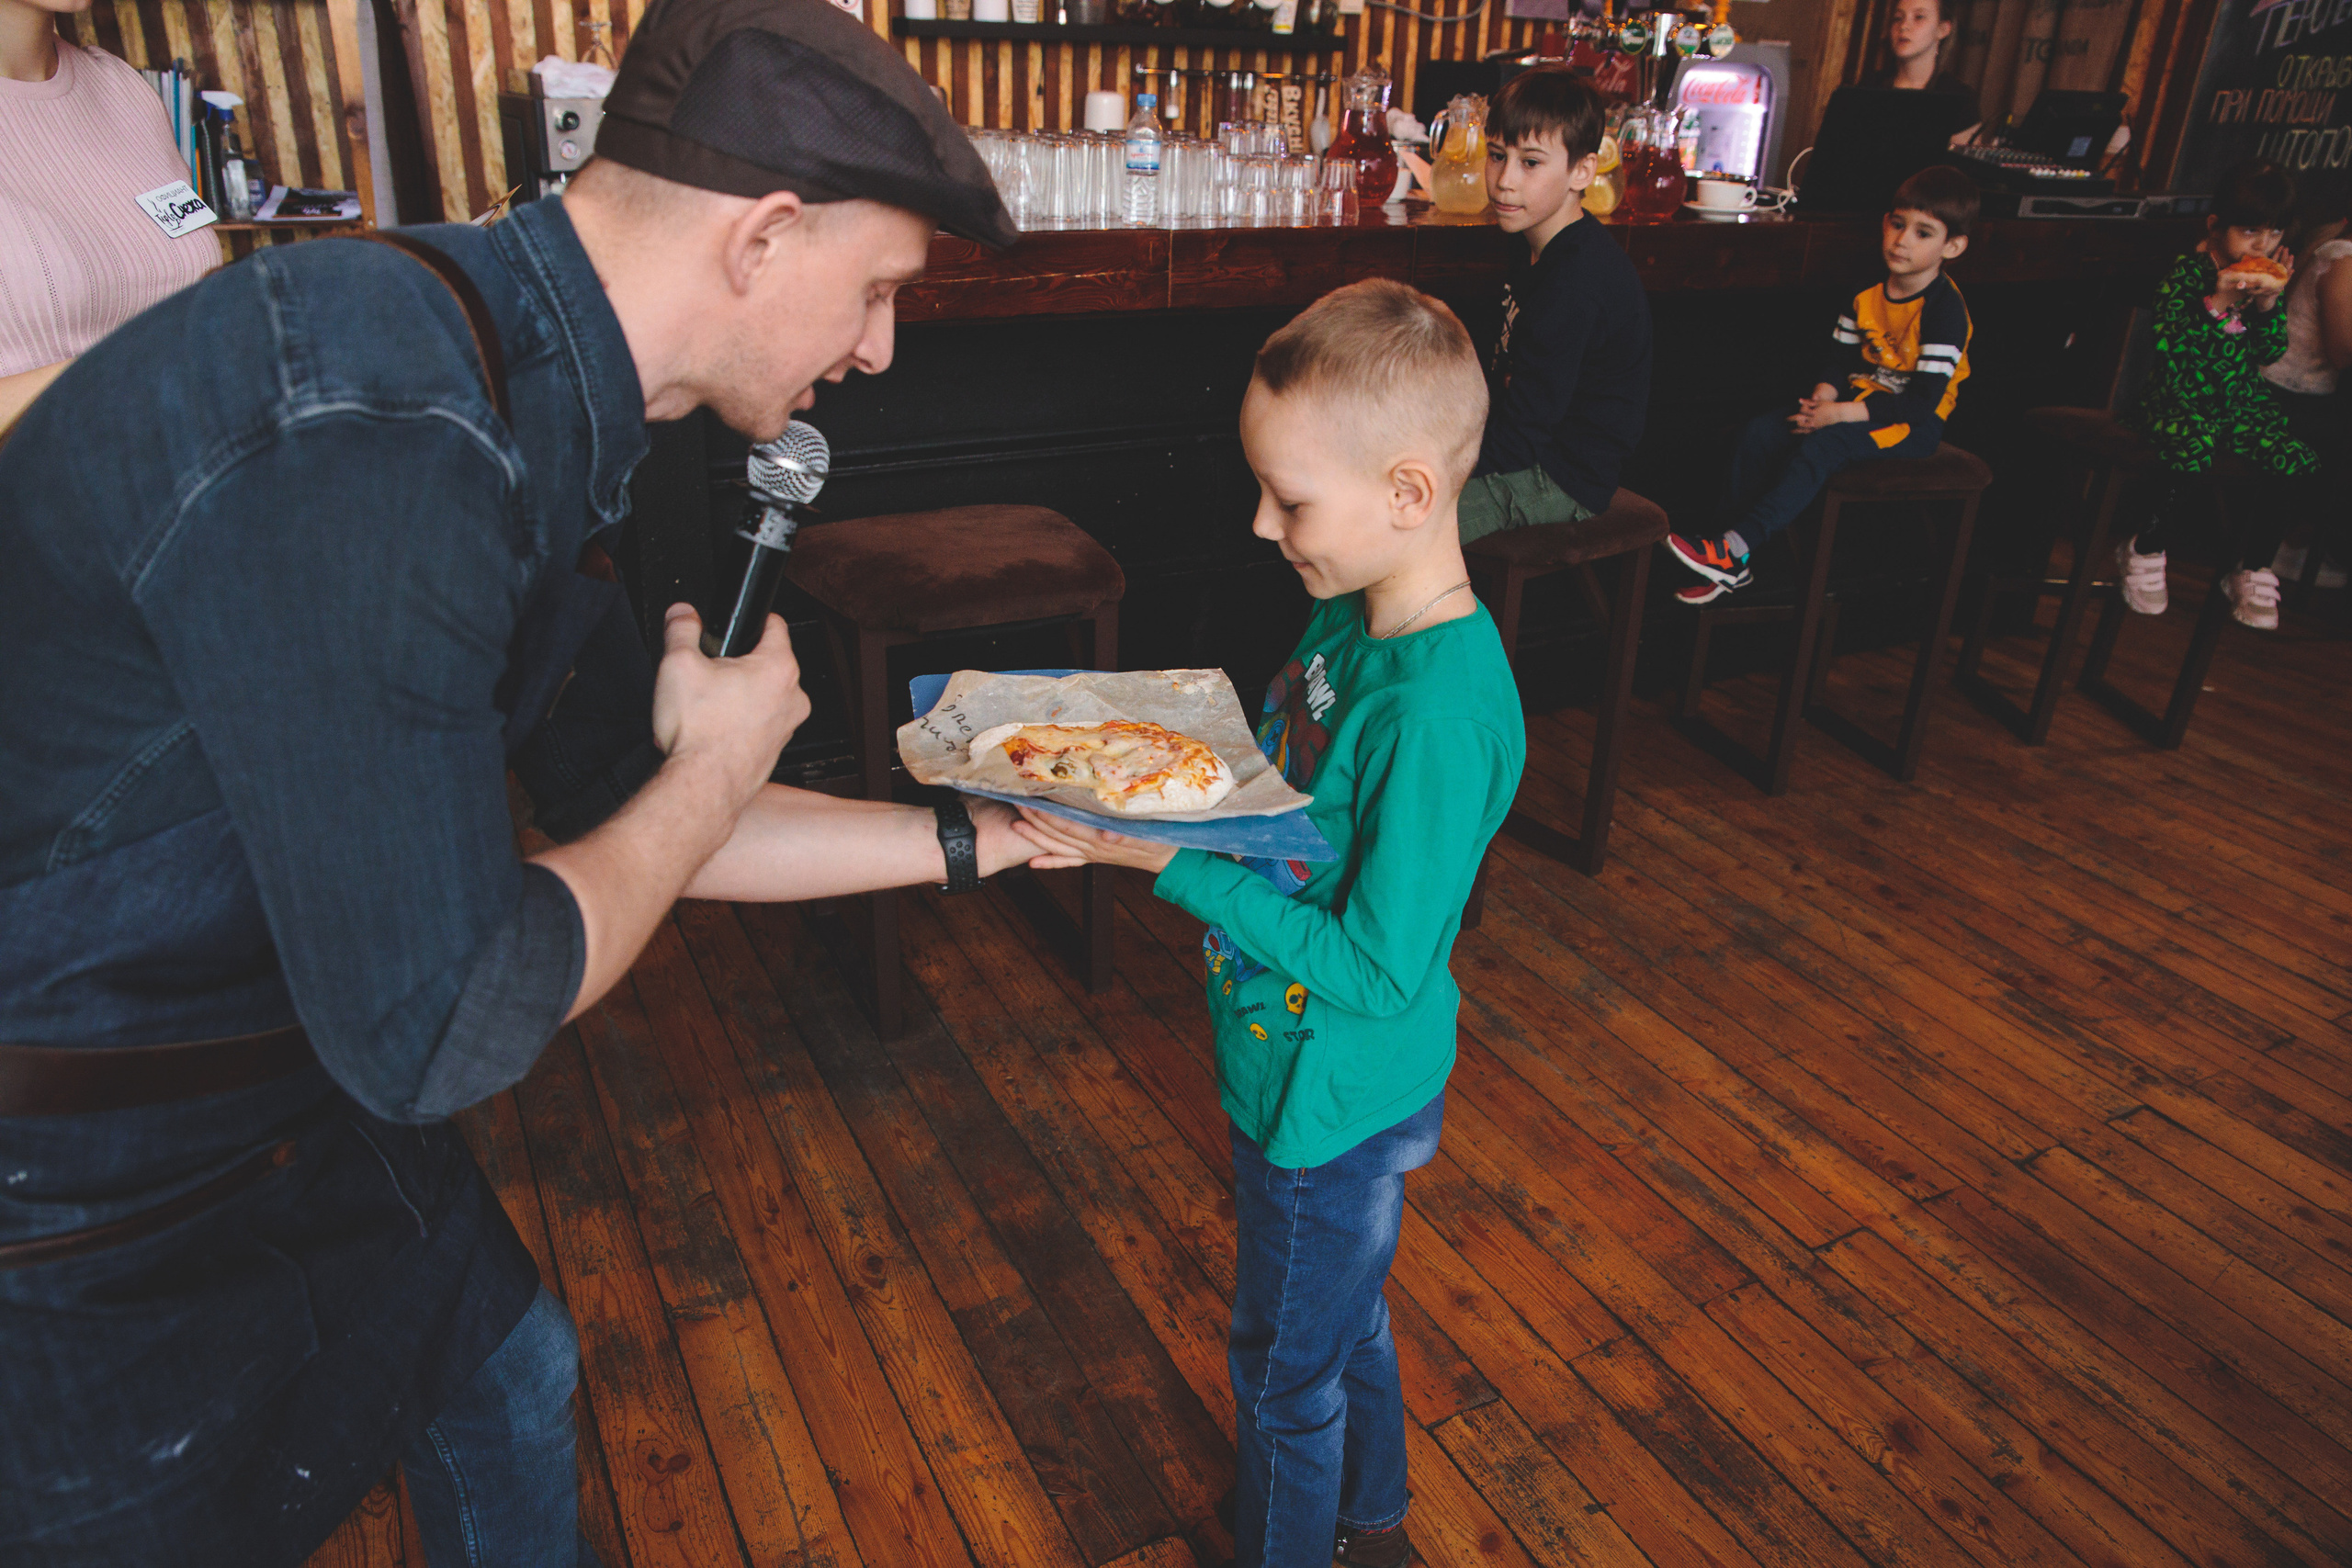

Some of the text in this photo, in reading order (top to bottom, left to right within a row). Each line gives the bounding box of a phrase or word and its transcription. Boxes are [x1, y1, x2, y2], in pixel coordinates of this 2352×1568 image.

[1682, 74, 1750, 105] Coca-Cola
[2256, 125, 2352, 171] ШТОПО
[155, 185, 189, 203] ОФИЦИАНТ
